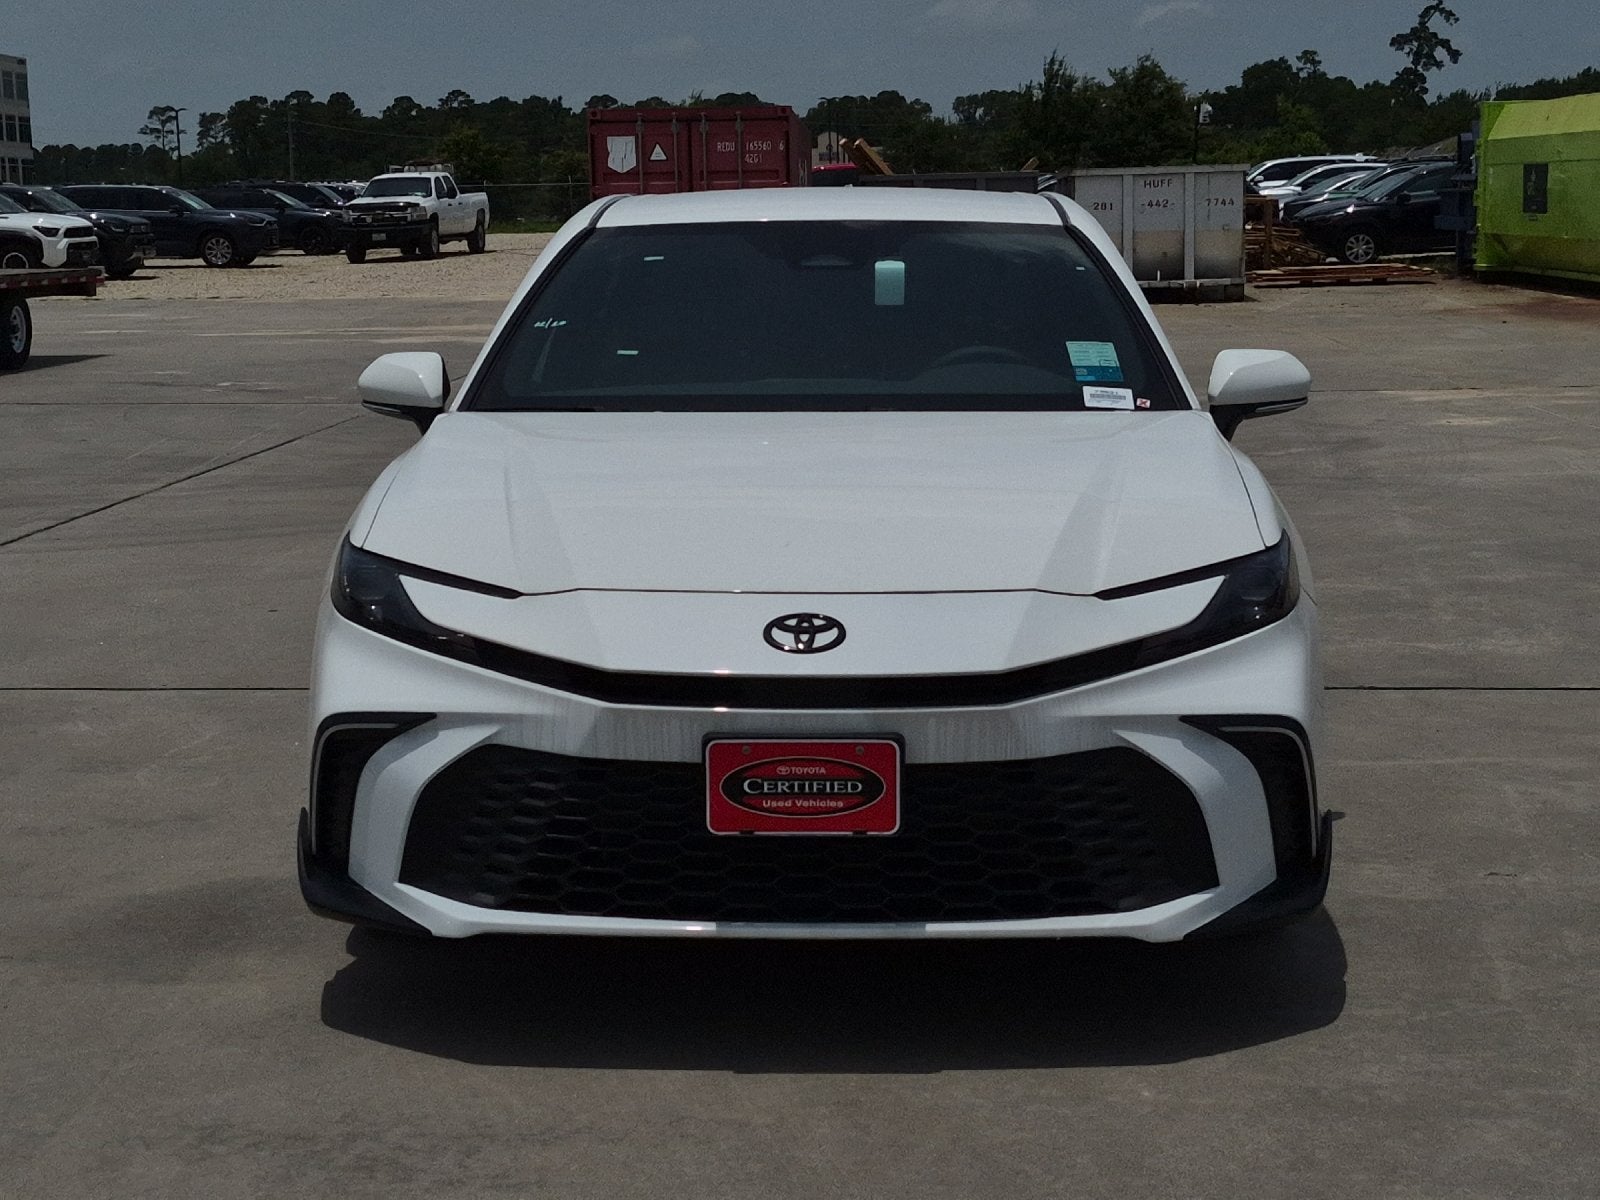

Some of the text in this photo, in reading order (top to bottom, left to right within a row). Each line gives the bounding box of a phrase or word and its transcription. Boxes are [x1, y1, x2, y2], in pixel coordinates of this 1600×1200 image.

[717, 142, 735, 152] REDU
[779, 140, 785, 151] 6
[1143, 178, 1174, 189] HUFF
[1206, 197, 1235, 207] 7744
[791, 766, 826, 775] TOYOTA
[743, 778, 863, 795] CERTIFIED
[762, 798, 844, 808] Used Vehicles
